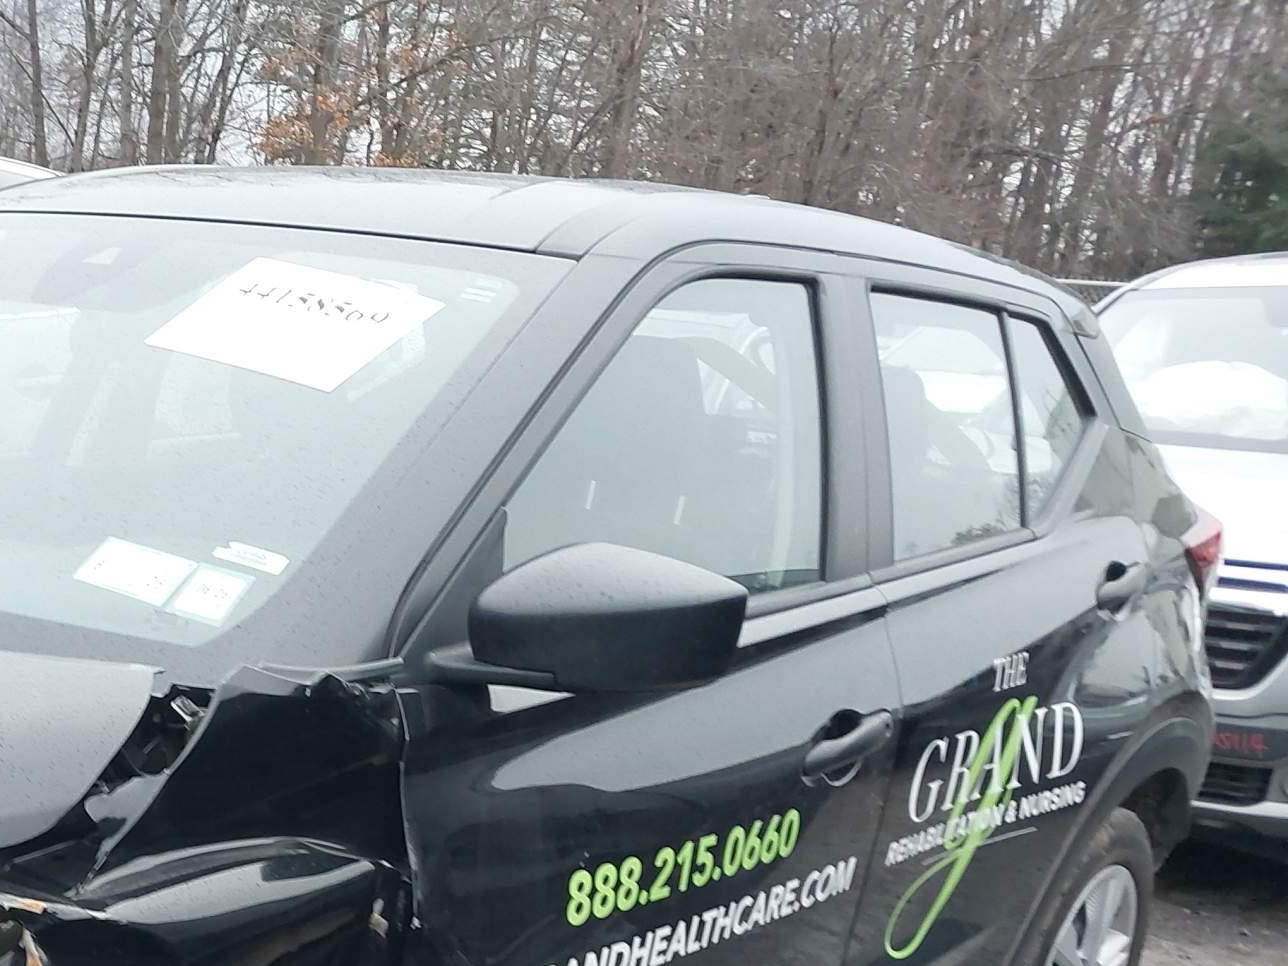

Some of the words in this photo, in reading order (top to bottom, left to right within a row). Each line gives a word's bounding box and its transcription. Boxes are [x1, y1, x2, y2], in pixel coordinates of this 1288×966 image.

[992, 651, 1030, 692] THE
[908, 701, 1085, 823] GRAND
[1018, 780, 1087, 820] NURSING
[565, 807, 802, 927] 888.215.0660
